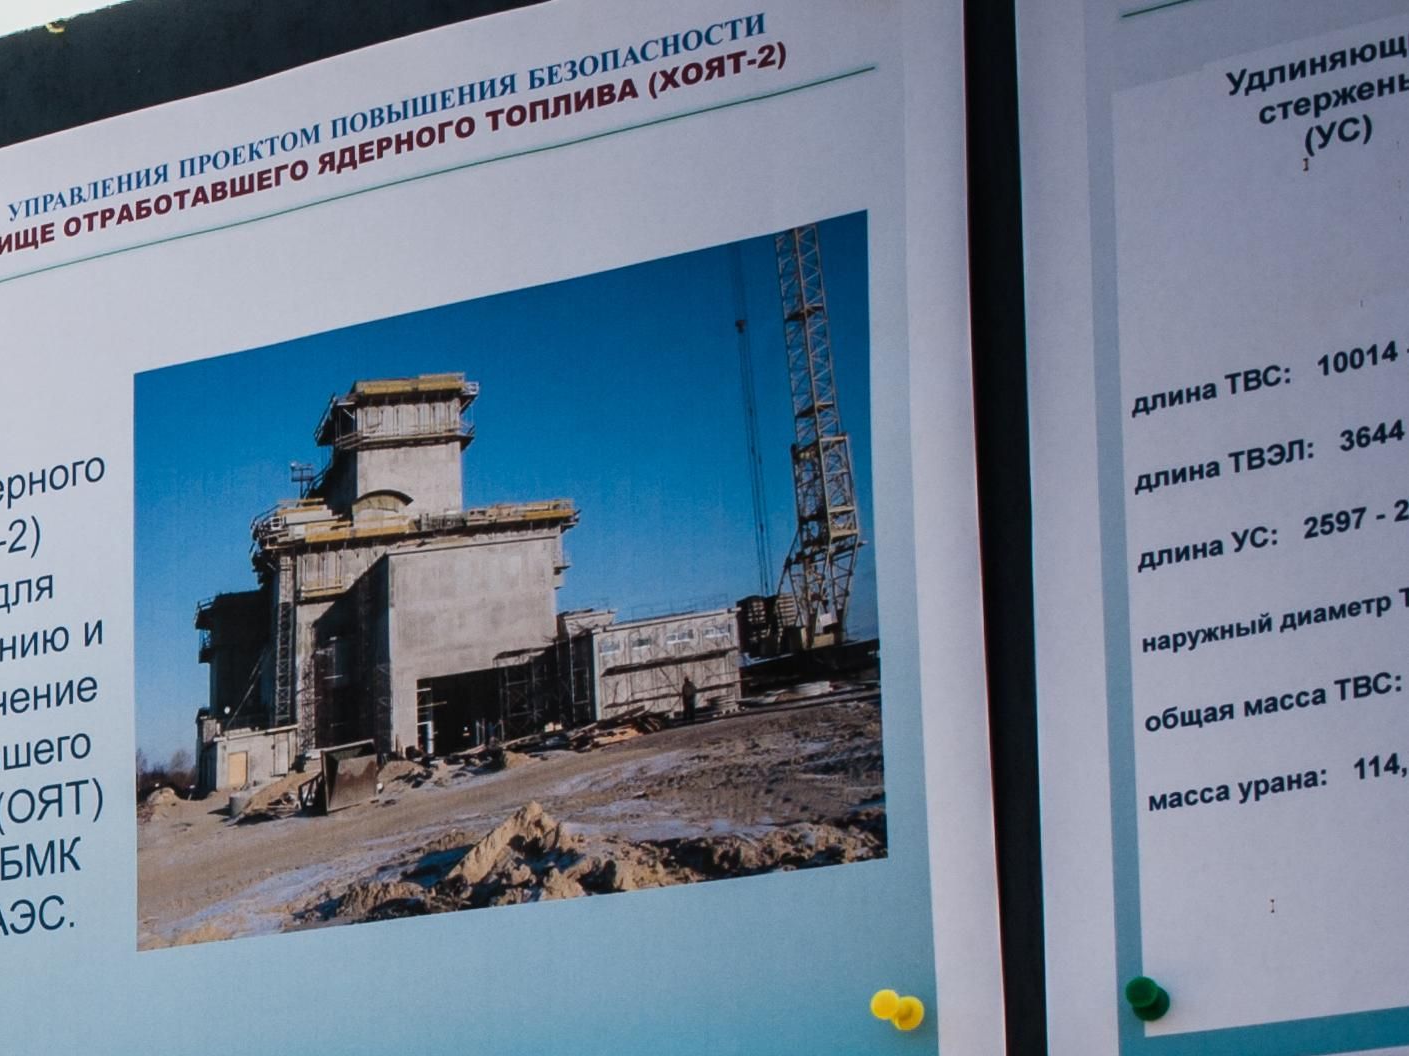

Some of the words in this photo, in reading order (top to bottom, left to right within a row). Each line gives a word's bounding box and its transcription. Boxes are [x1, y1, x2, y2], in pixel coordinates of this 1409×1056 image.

[1226, 34, 1409, 96] Удлиняющ
[9, 164, 167, 221] УПРАВЛЕНИЯ
[180, 124, 319, 178] ПРОЕКТОМ
[332, 74, 516, 138] ПОВЫШЕНИЯ
[529, 13, 765, 89] БЕЗОПАСНОСТИ
[1259, 74, 1409, 124] стержень
[64, 160, 308, 236] ОТРАБОТАВШЕГО
[318, 117, 475, 174] ЯДЕРНОГО
[486, 79, 639, 131] ТОПЛИВА
[649, 42, 786, 99] (ХОЯТ-2)
[1305, 114, 1372, 156] (УС)
[1132, 383, 1217, 418] длина
[1225, 365, 1290, 394] ТВС:
[1318, 341, 1398, 376] 10014
[1135, 461, 1220, 495] длина
[1228, 439, 1313, 473] ТВЭЛ:
[1340, 420, 1405, 451] 3644
[1138, 540, 1223, 573] длина
[1231, 526, 1277, 552] УС:
[1304, 507, 1366, 539] 2597
[85, 620, 102, 646] и
[1143, 613, 1272, 653] наружный
[1280, 596, 1391, 633] диаметр
[1145, 704, 1234, 732] общая
[1244, 688, 1326, 717] масса
[1334, 672, 1401, 701] ТВС:
[1149, 785, 1230, 811] масса
[1238, 769, 1326, 804] урана:
